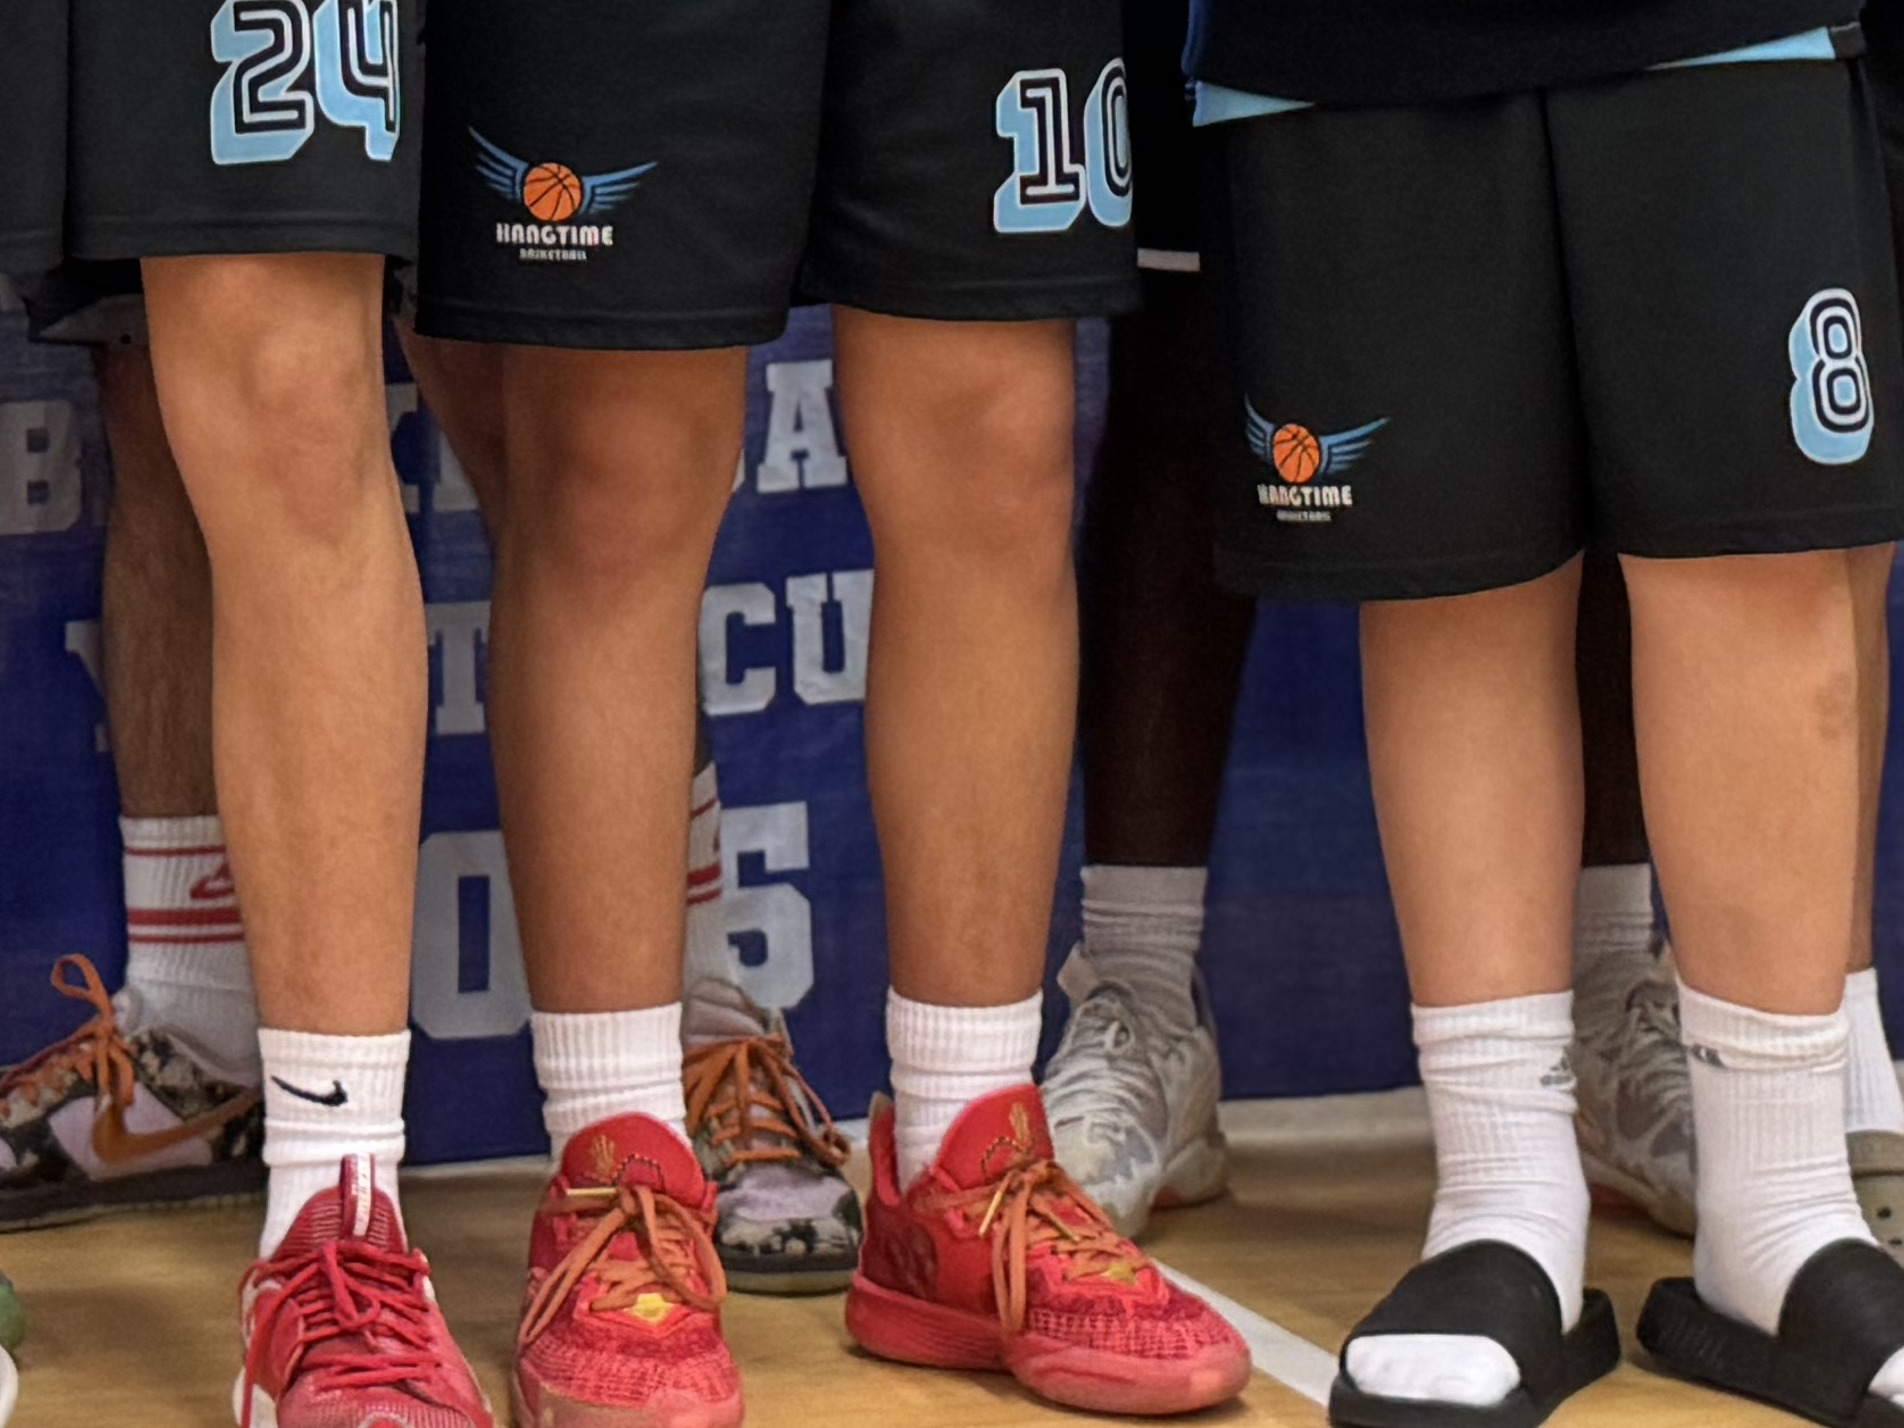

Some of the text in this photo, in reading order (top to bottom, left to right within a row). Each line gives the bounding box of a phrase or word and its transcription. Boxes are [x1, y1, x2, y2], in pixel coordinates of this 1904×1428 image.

[993, 57, 1133, 234] 10
[496, 223, 614, 246] HANGTIME
[1788, 287, 1875, 466] 8
